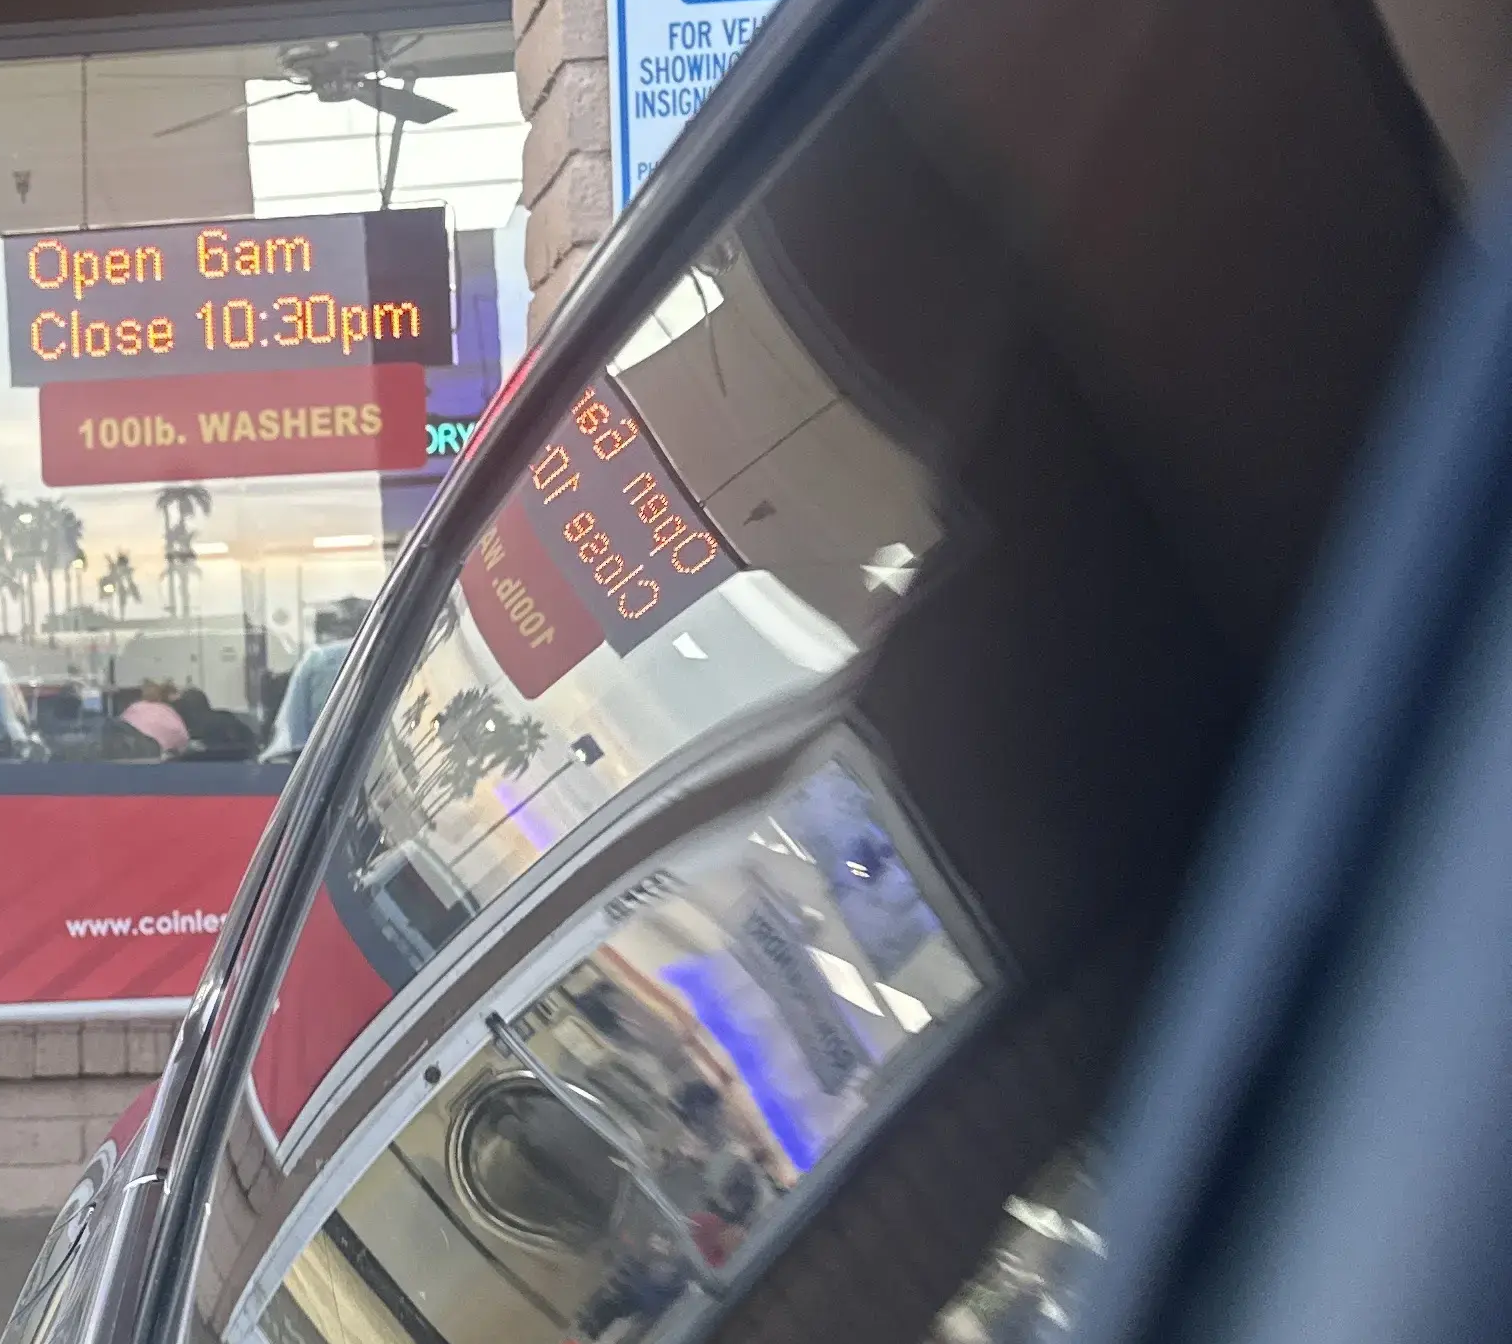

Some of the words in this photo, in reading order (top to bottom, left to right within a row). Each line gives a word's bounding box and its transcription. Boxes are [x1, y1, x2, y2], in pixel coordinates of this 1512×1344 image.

[669, 20, 713, 51] FOR
[28, 238, 165, 301] Open
[196, 227, 312, 279] 6am
[30, 309, 176, 361] Close
[195, 293, 420, 356] 10:30pm
[78, 415, 187, 449] 100lb.
[198, 403, 383, 445] WASHERS
